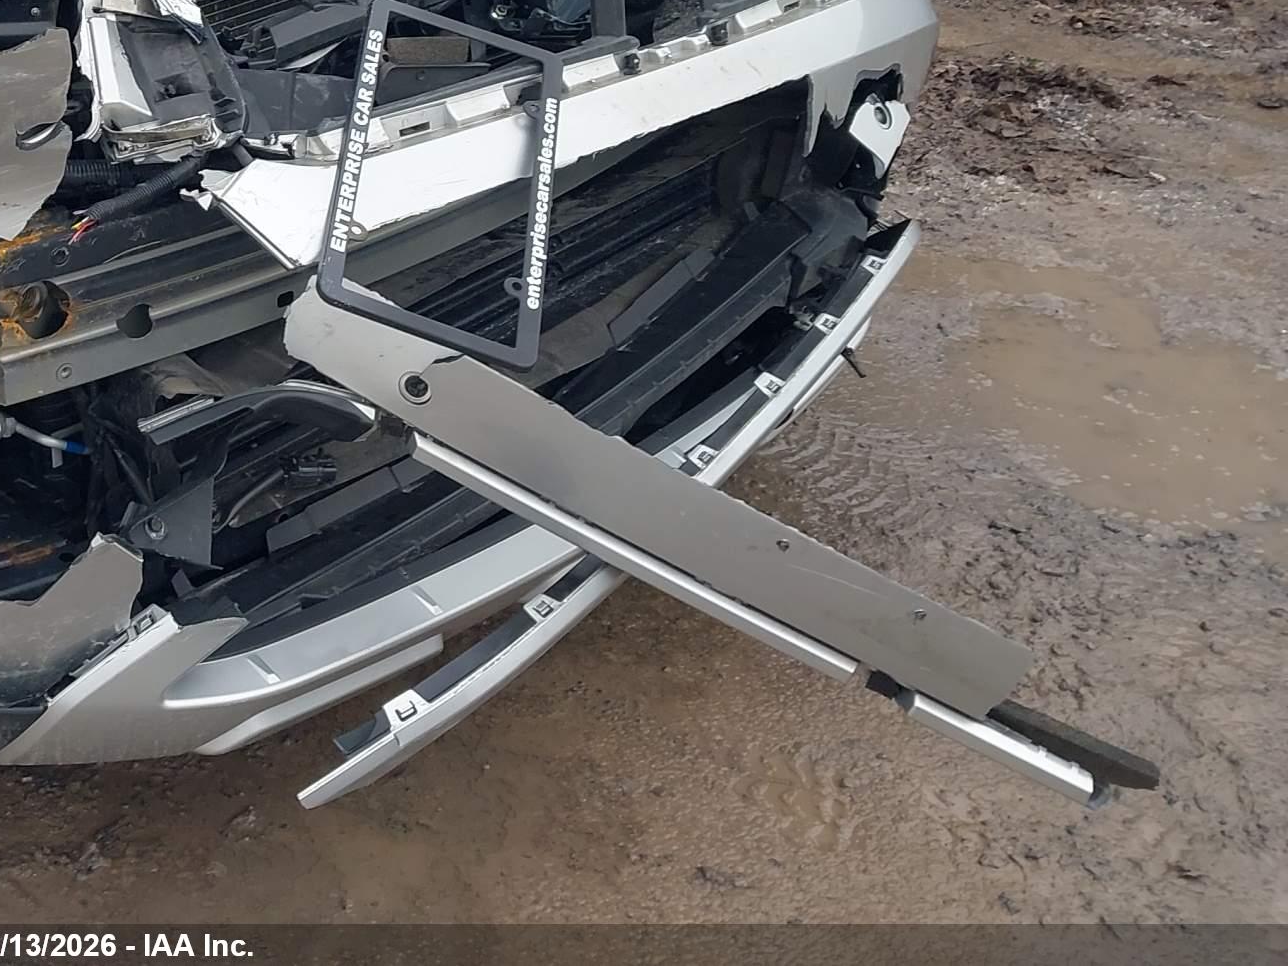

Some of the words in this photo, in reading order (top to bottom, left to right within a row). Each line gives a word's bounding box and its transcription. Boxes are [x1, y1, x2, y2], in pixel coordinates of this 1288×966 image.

[361, 29, 384, 87] SALES
[353, 89, 375, 127] CAR
[330, 128, 368, 252] ENTERPRISE
[526, 97, 558, 310] enterprisecarsales.com
